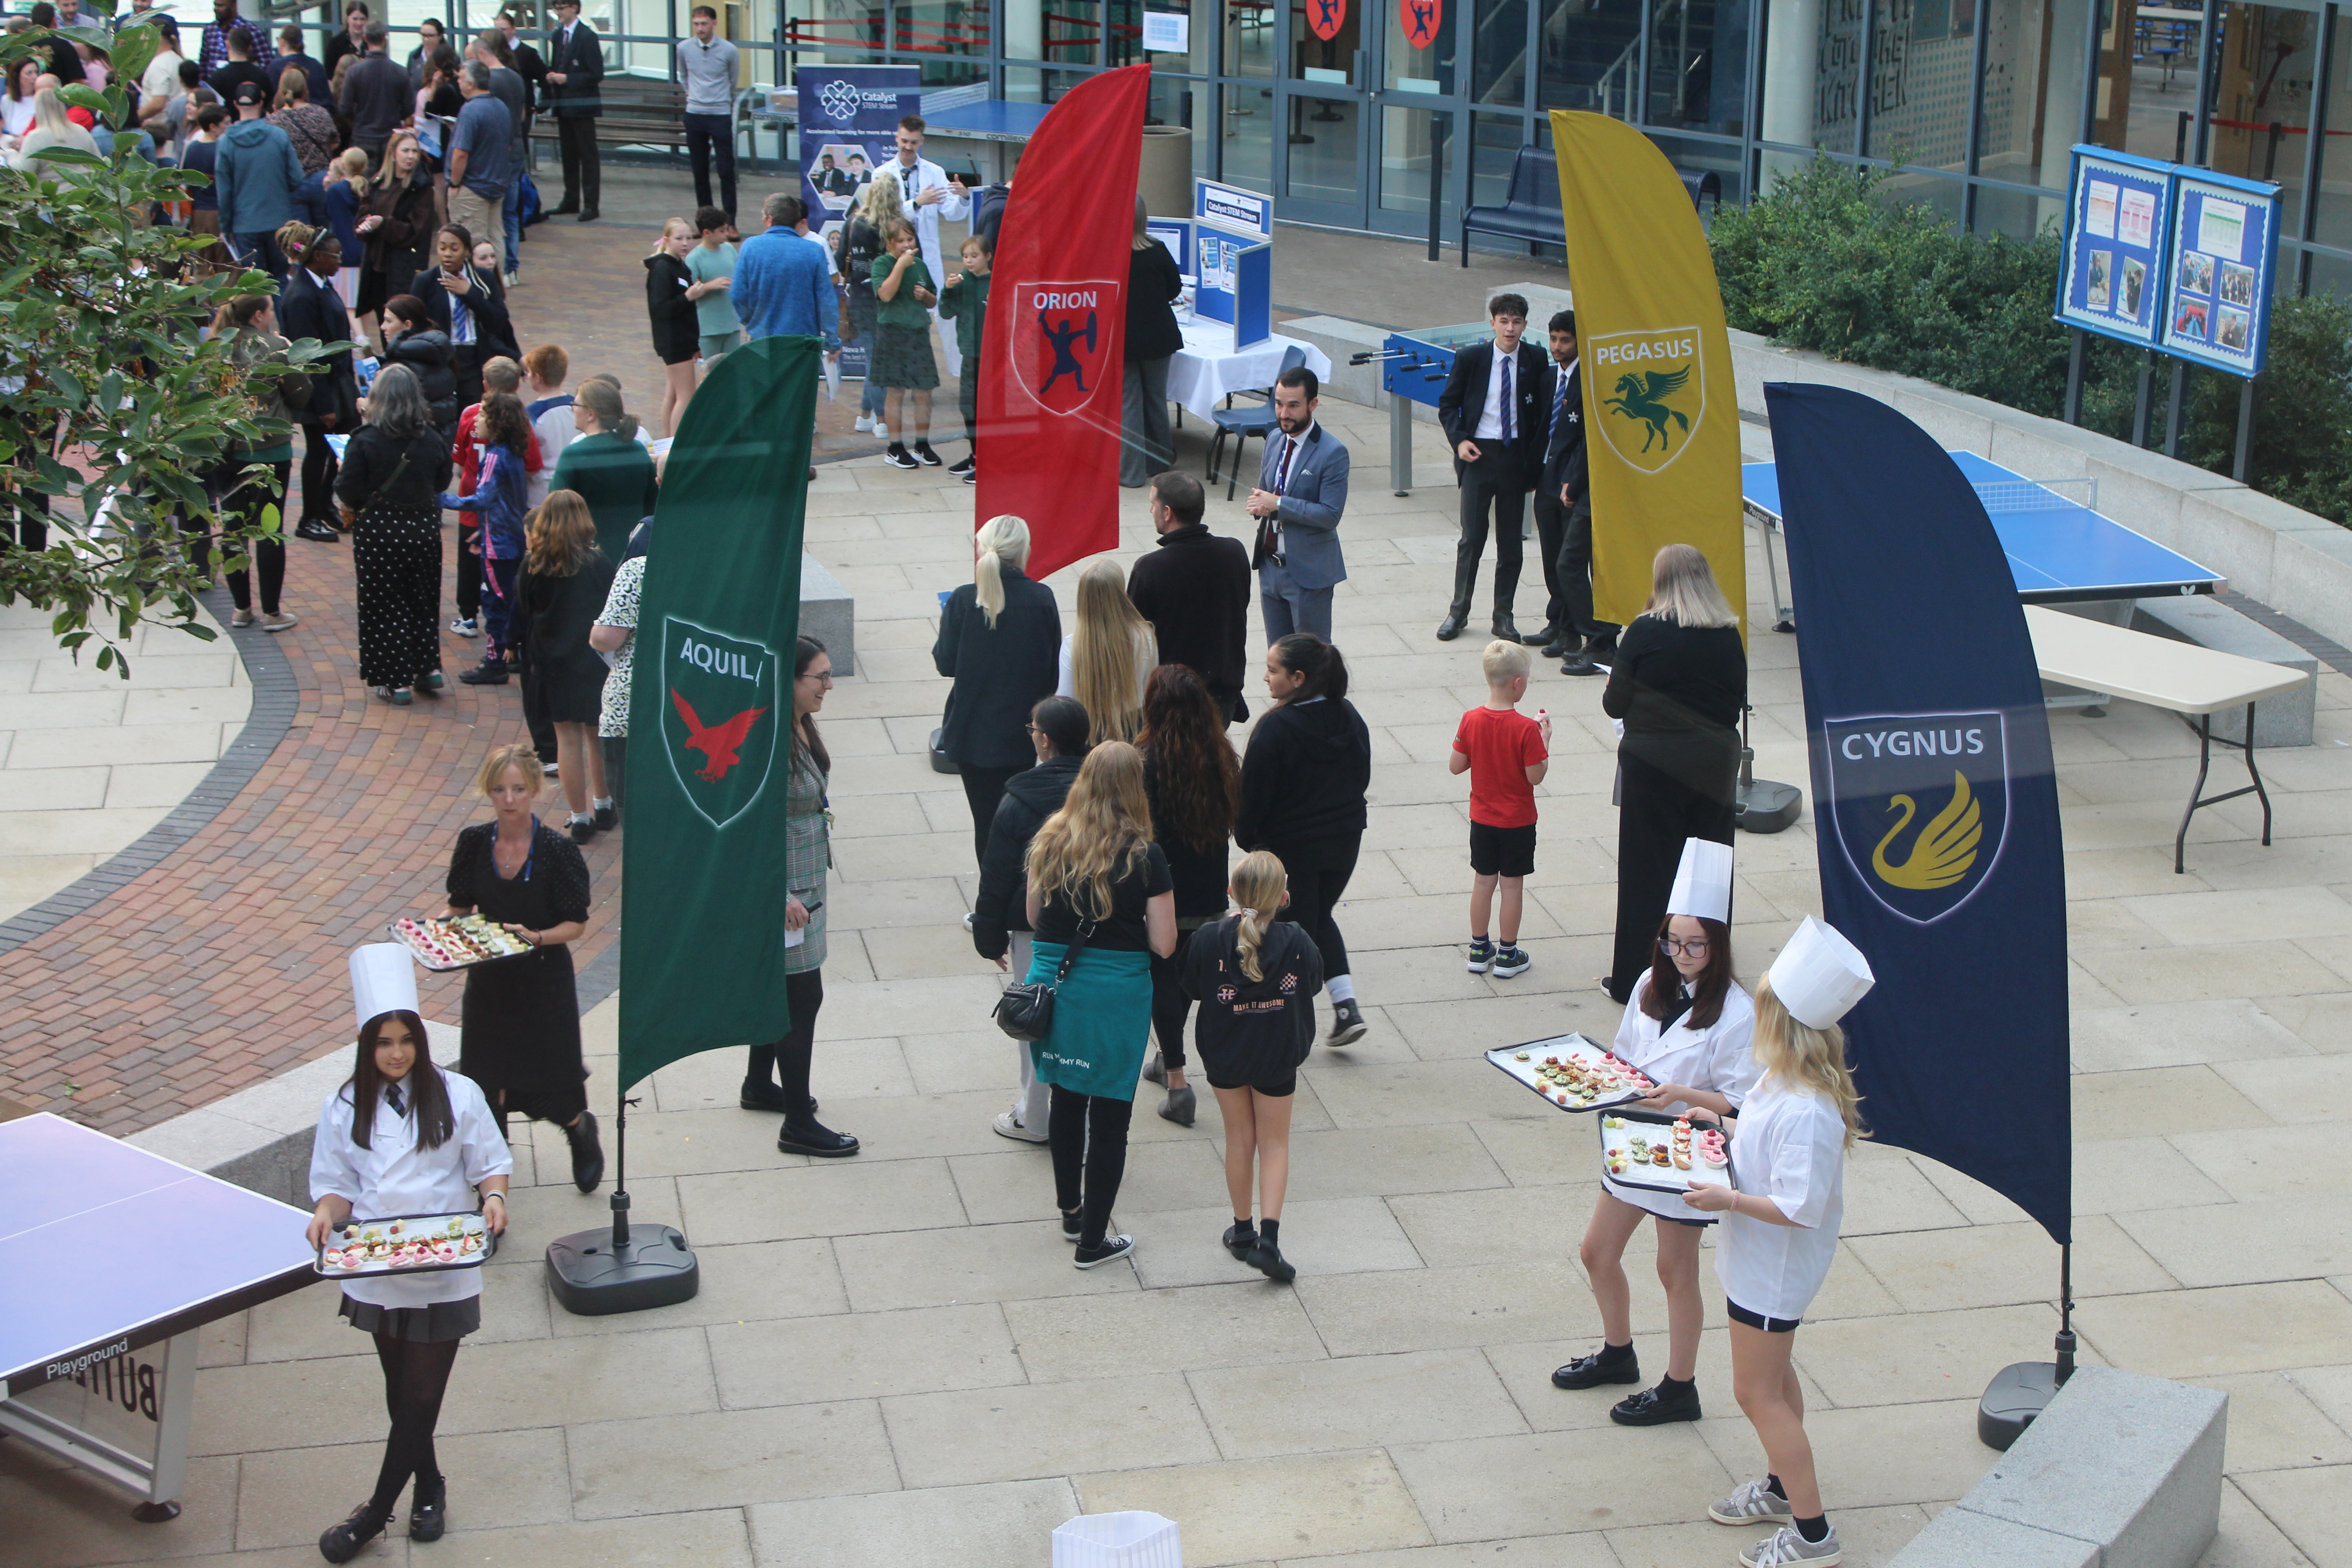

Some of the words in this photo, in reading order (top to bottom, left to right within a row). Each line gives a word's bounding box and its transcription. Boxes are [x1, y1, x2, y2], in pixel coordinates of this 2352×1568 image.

[862, 92, 897, 103] Catalyst
[1208, 201, 1228, 214] Catalyst
[1227, 206, 1240, 218] STEM
[1240, 209, 1257, 222] Stream
[1033, 291, 1097, 309] ORION
[1597, 338, 1693, 365] PEGASUS
[1749, 505, 1769, 524] Playground
[1842, 729, 1984, 760] CYGNUS
[1233, 1002, 1250, 1012] MAKE
[1258, 999, 1285, 1009] AWESOME
[1042, 1052, 1054, 1060] RUN
[1076, 1059, 1090, 1068] RUN
[46, 1337, 128, 1380] Playground
